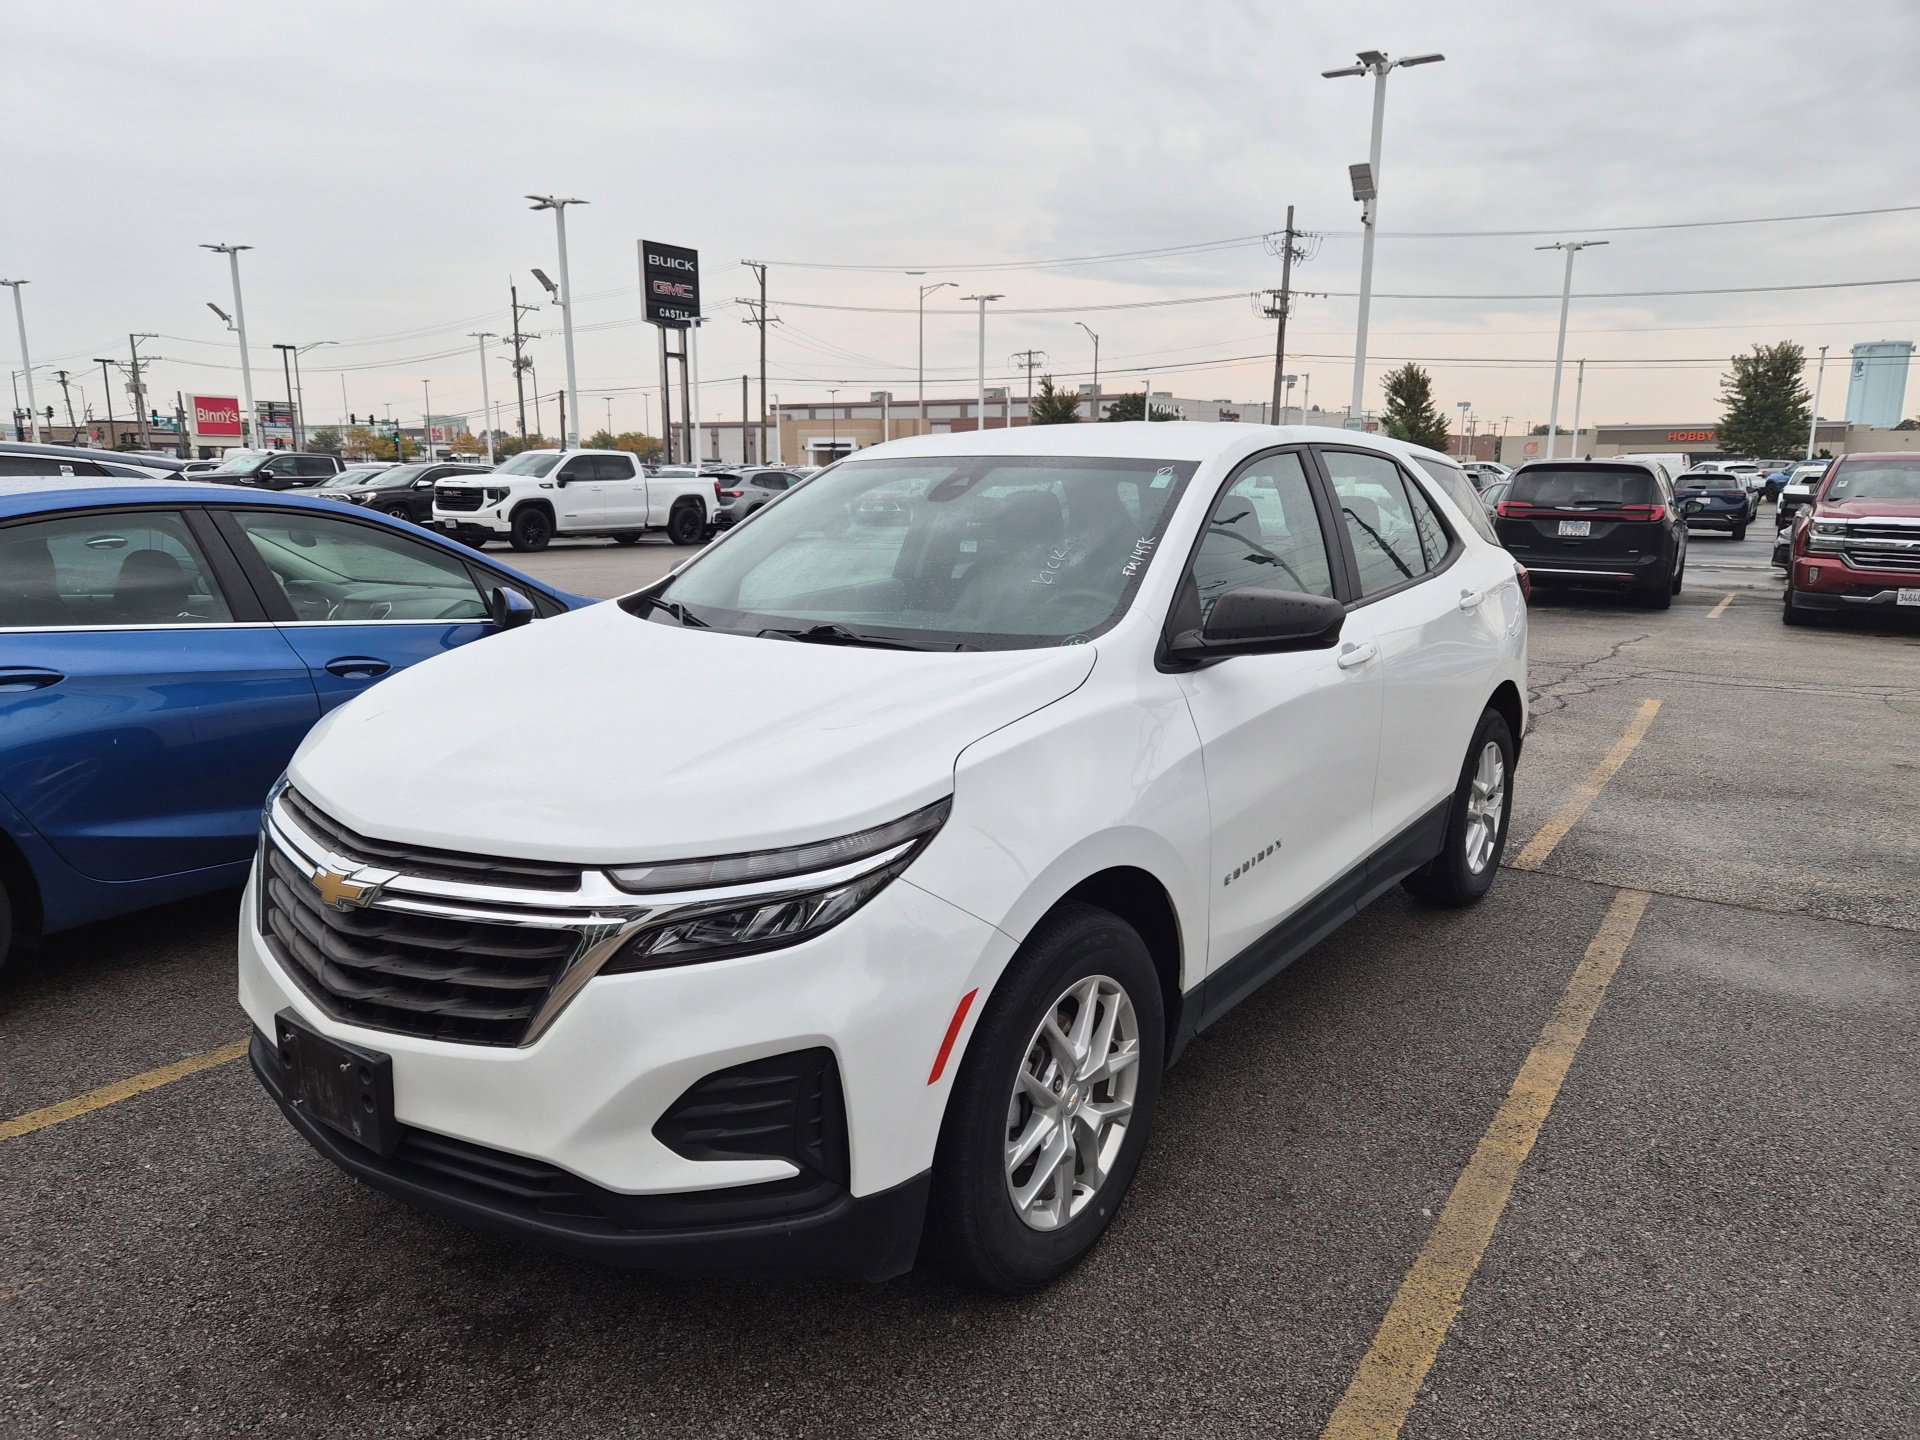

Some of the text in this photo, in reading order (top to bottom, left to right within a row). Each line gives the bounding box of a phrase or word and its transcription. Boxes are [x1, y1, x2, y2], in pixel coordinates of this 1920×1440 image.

[648, 254, 695, 272] BUICK
[653, 280, 694, 299] GMC
[659, 308, 690, 320] CASTLE
[1667, 431, 1715, 442] HOBBY
